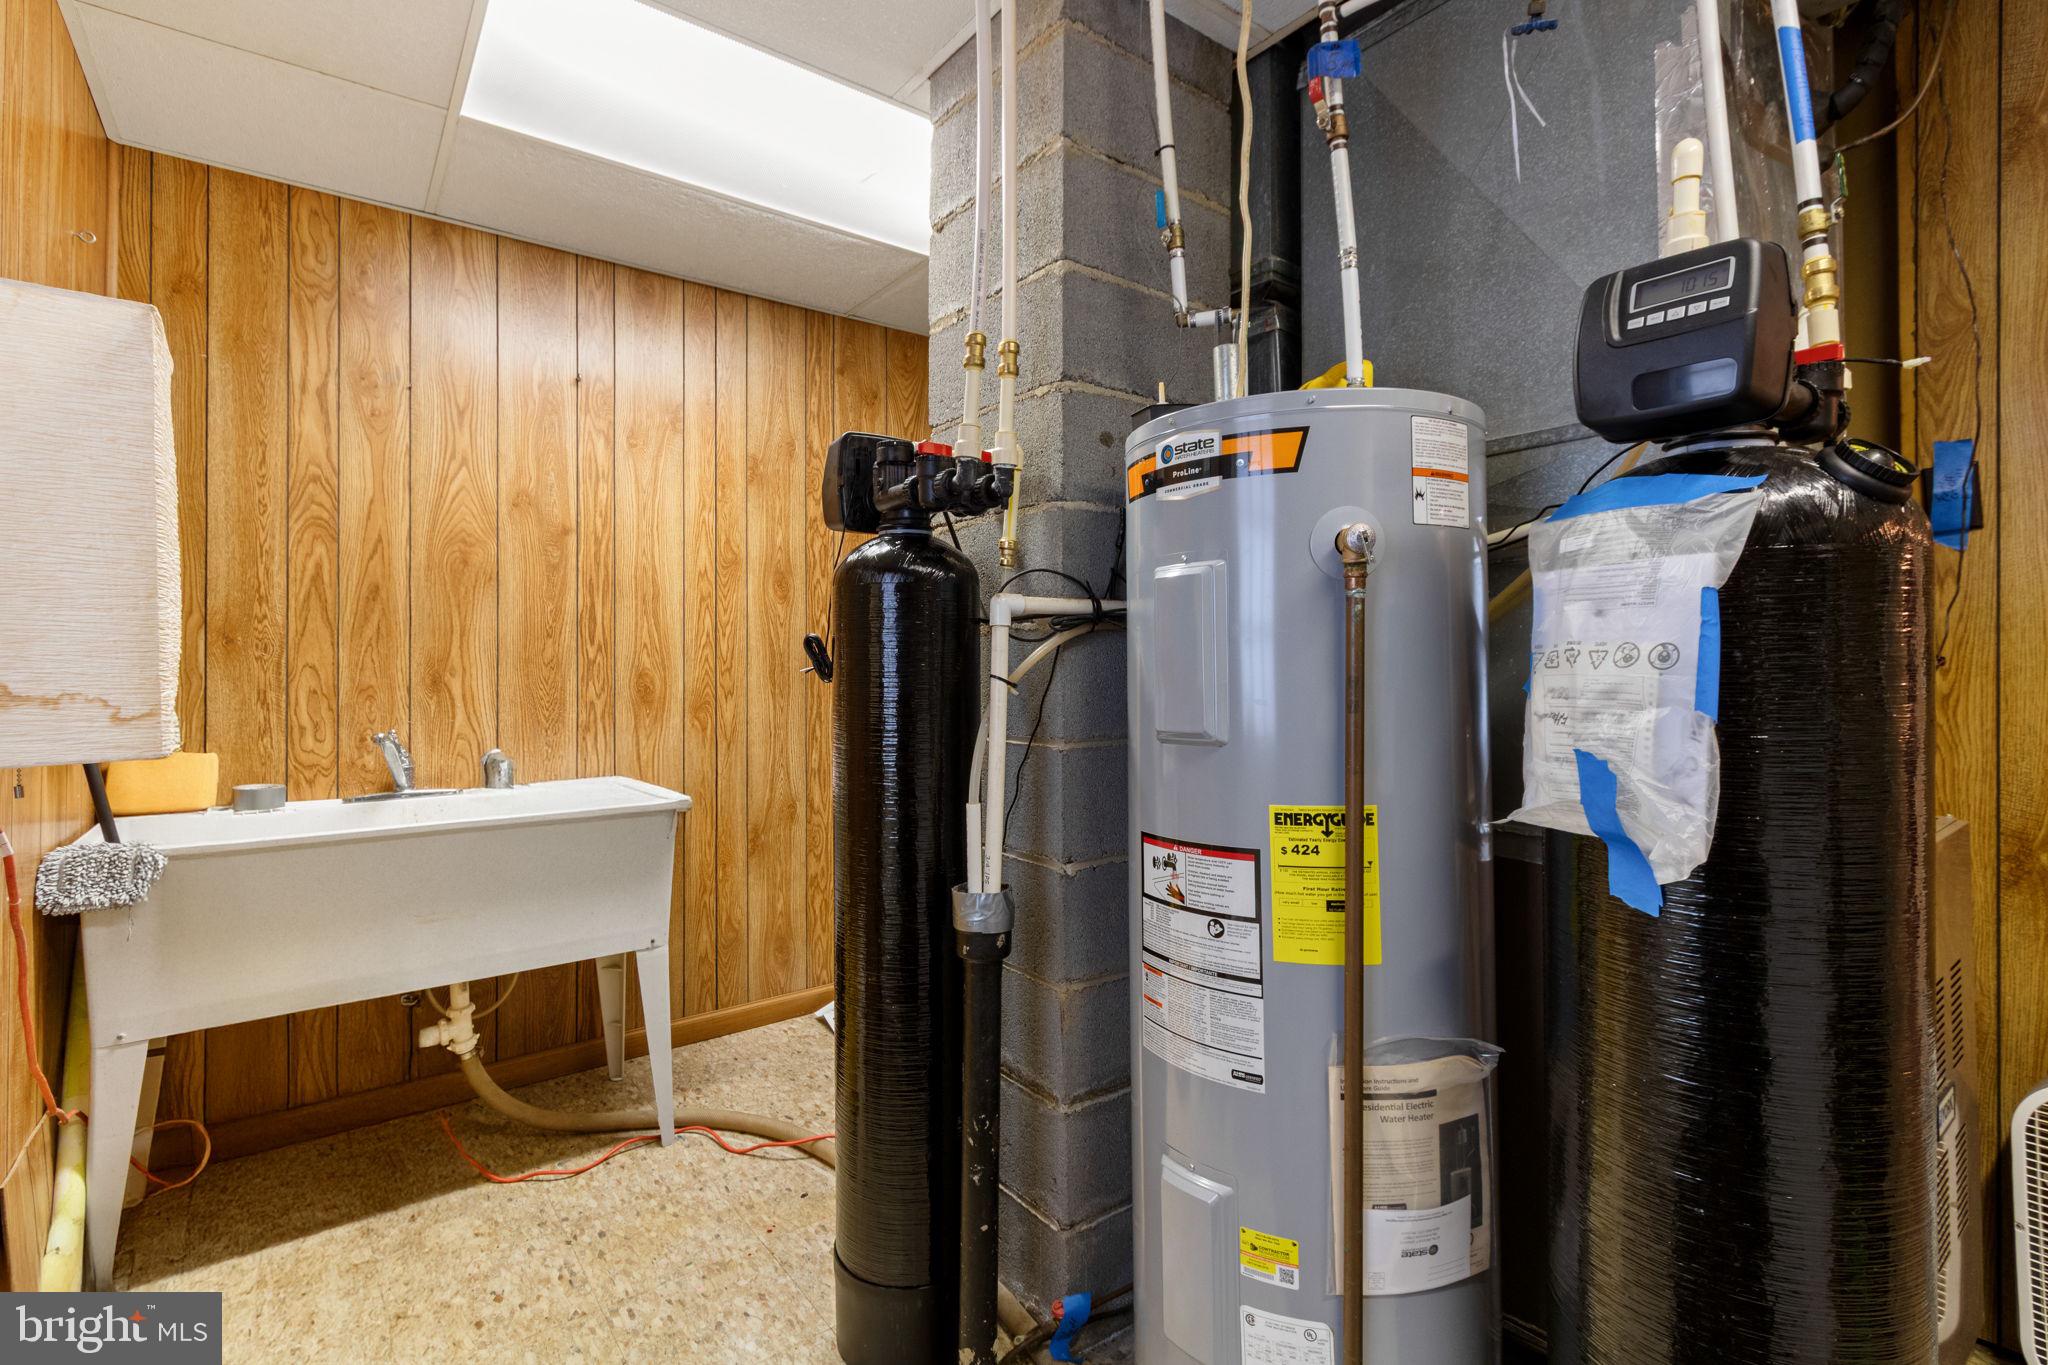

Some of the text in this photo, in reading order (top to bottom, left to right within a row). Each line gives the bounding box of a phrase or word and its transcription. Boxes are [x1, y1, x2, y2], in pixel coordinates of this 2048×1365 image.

[1174, 438, 1214, 455] state
[1180, 845, 1202, 855] DANGER
[1280, 844, 1320, 856] $ 424
[1362, 1100, 1434, 1112] esidential Electric
[1380, 1112, 1434, 1124] Water Heater
